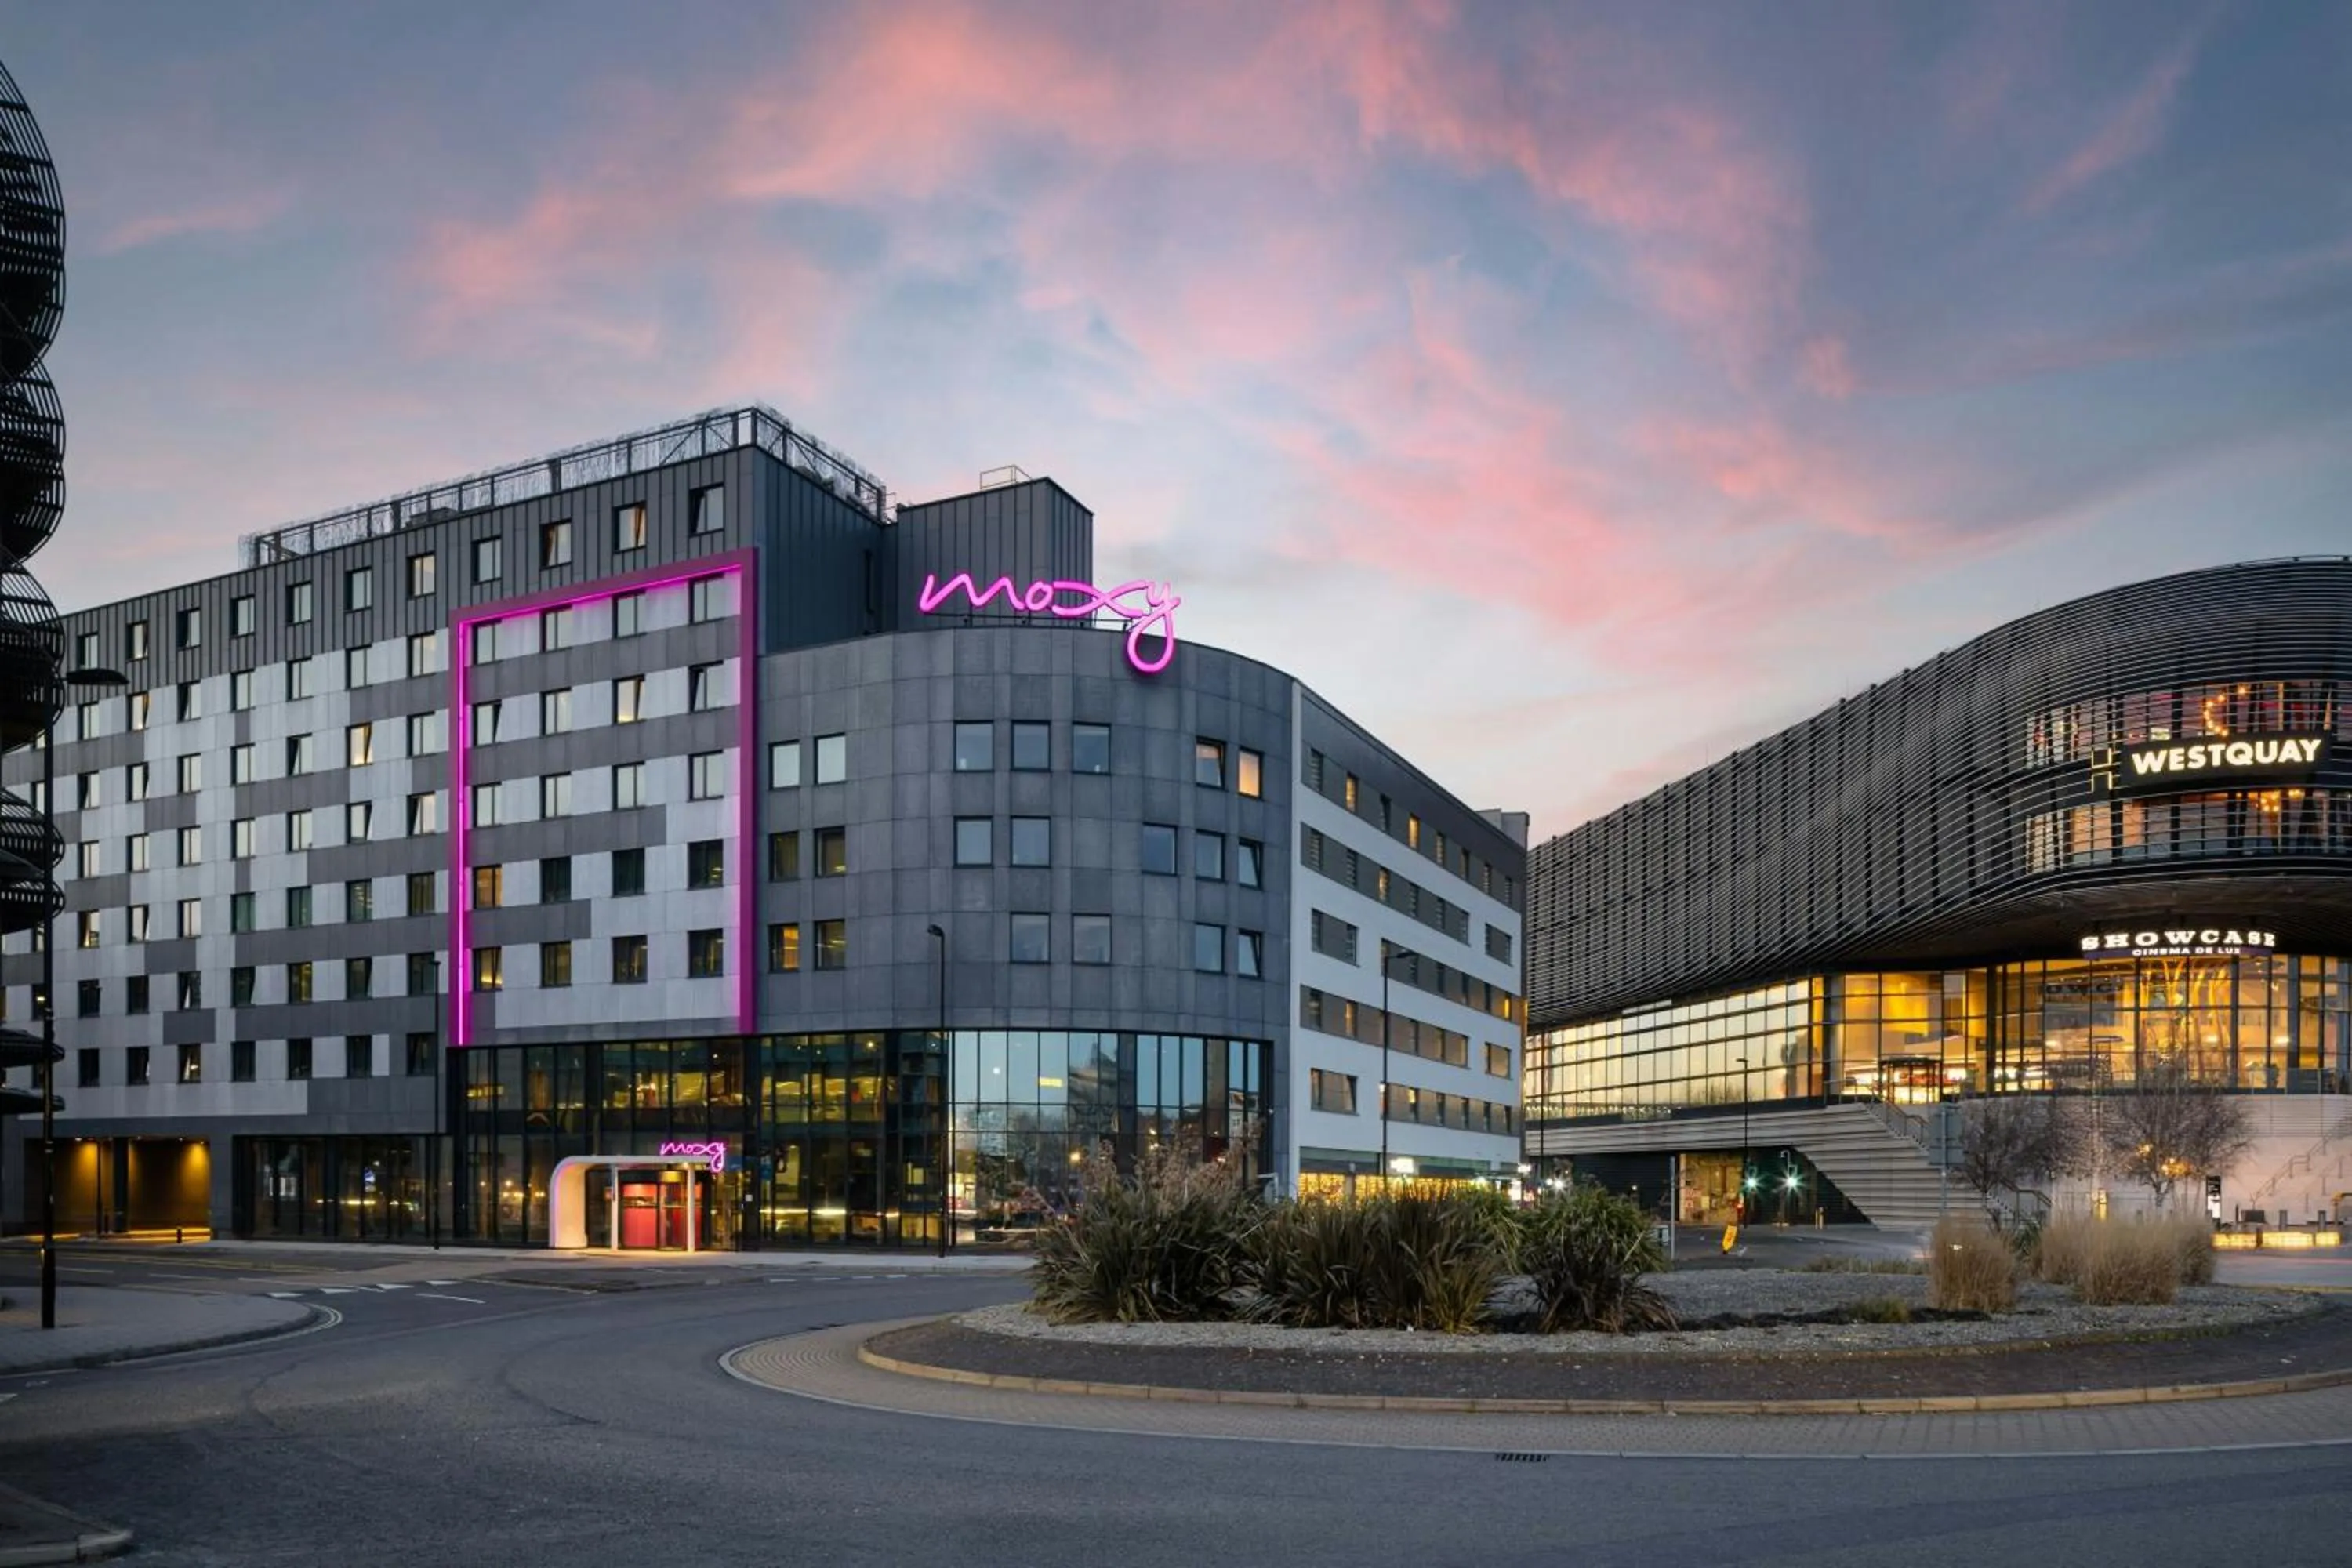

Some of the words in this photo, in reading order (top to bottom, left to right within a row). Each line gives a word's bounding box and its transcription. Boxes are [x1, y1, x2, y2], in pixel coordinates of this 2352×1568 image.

[920, 573, 1181, 673] moxy
[2131, 739, 2321, 775] WESTQUAY
[2082, 930, 2276, 950] SHOWCASE
[2132, 947, 2190, 956] CINEMA
[660, 1142, 726, 1173] moxy
